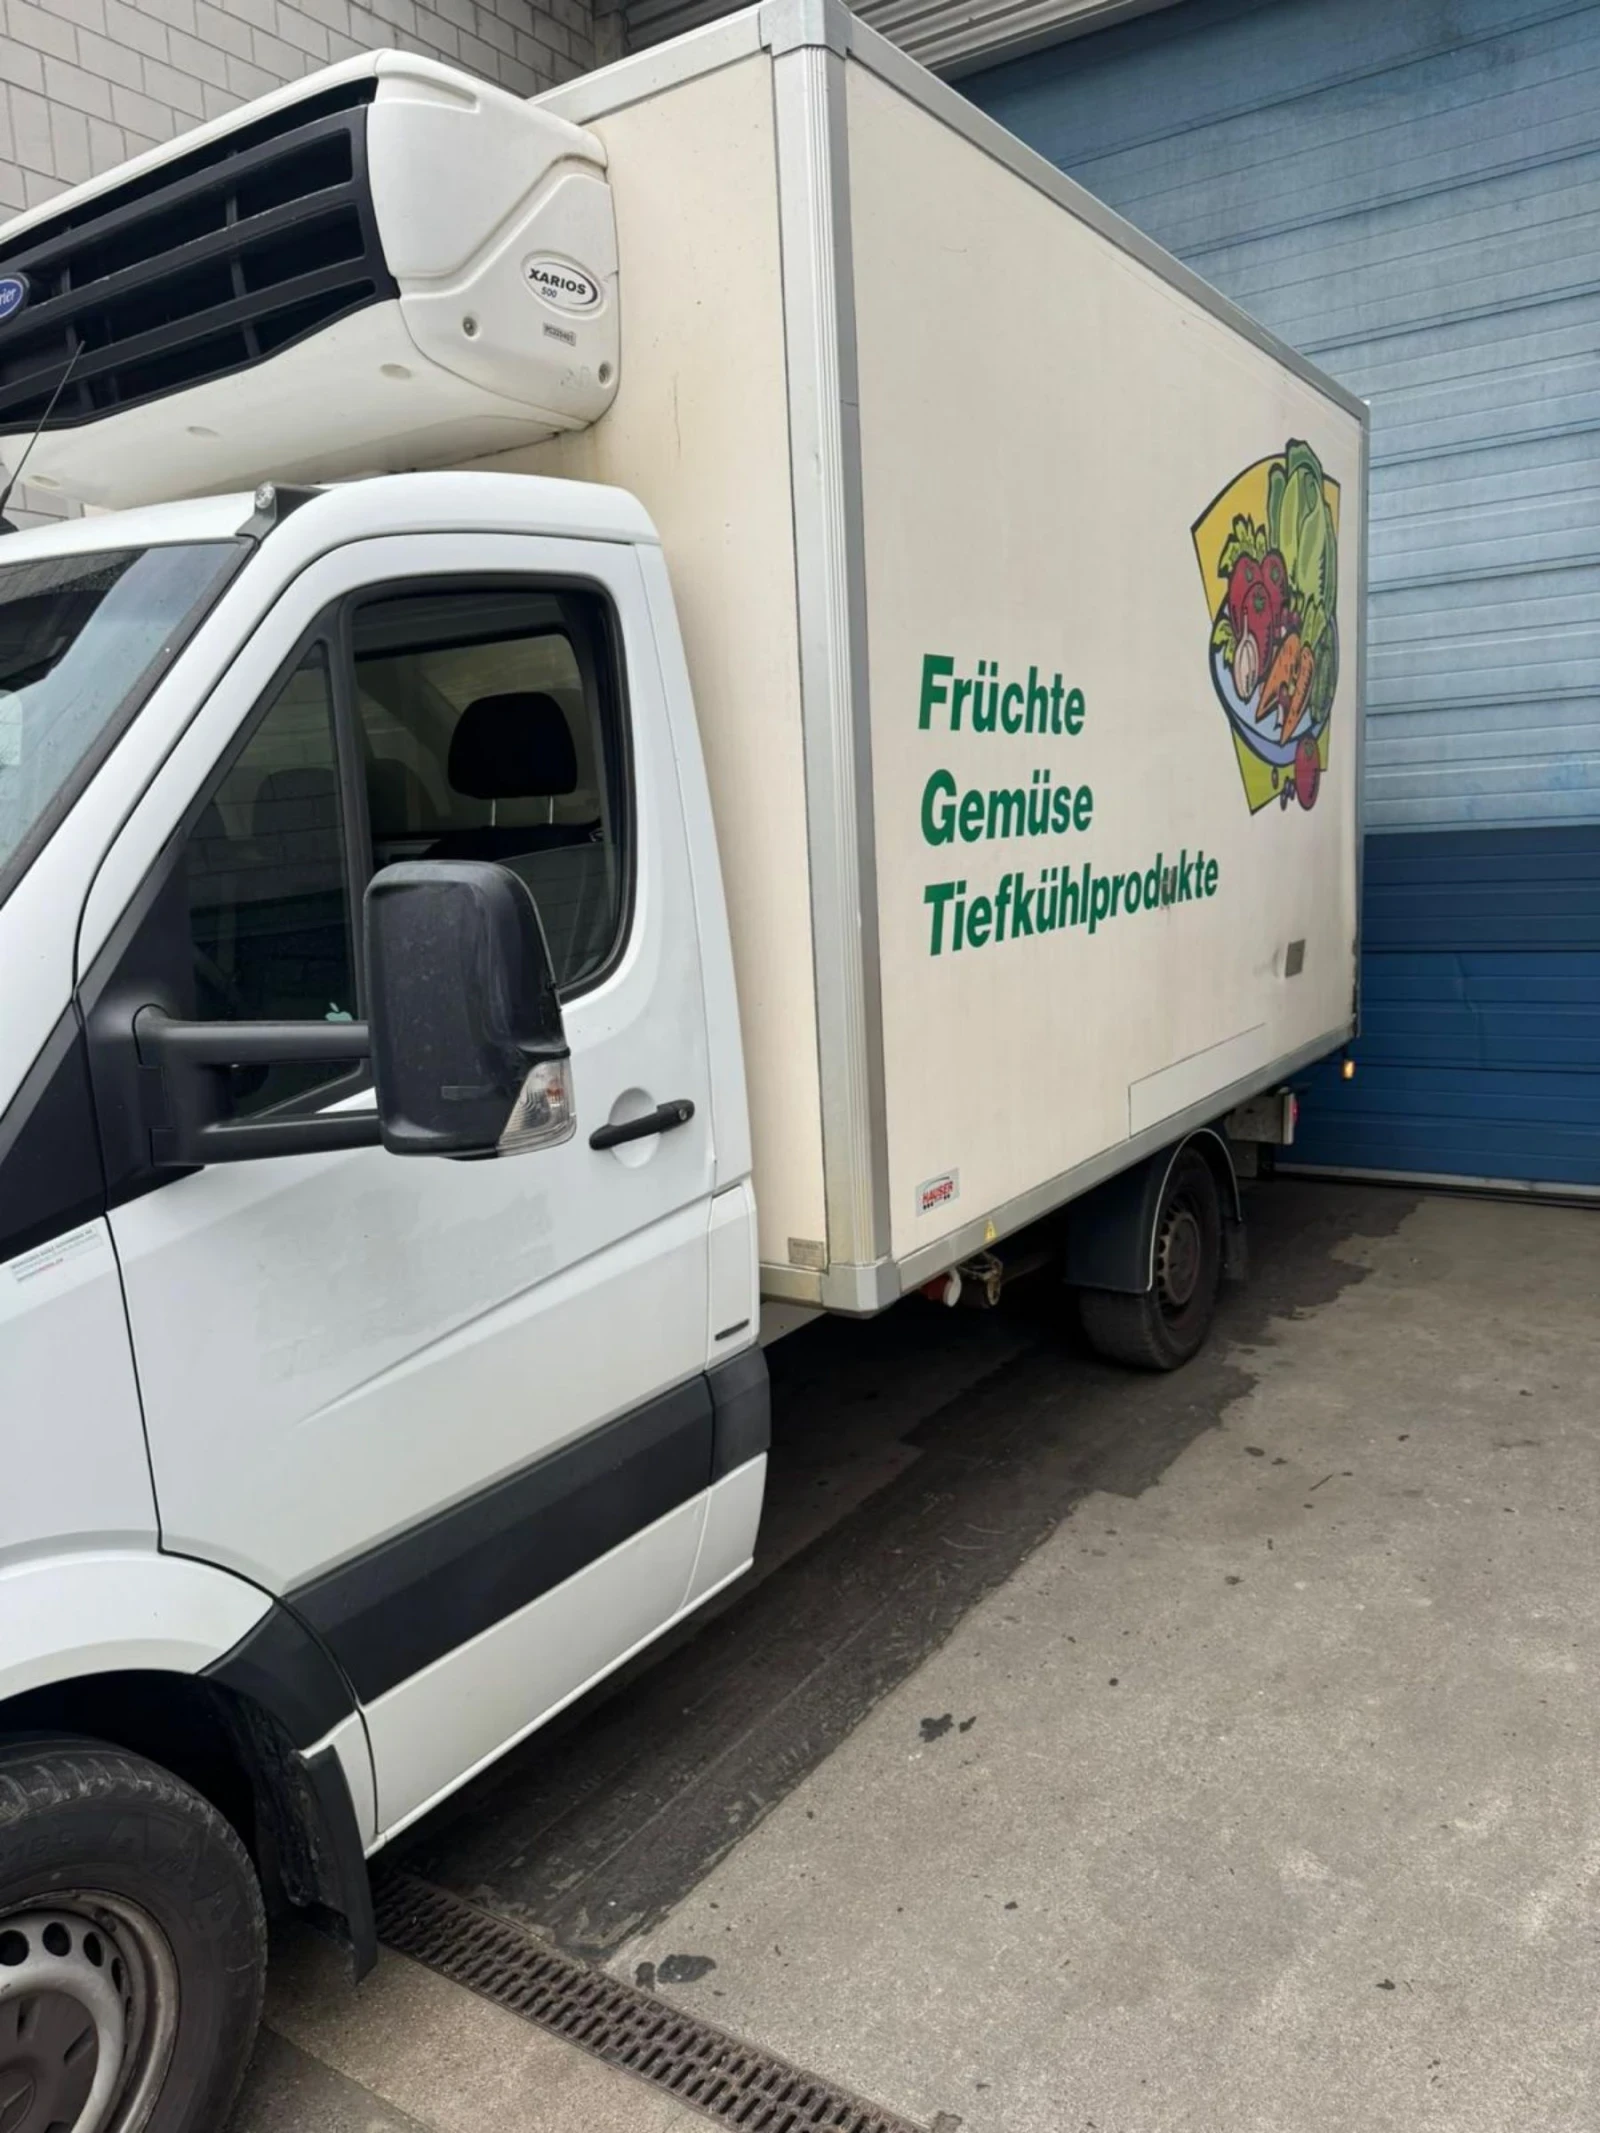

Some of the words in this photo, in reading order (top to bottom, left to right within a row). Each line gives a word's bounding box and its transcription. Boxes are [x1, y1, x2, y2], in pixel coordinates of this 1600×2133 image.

[529, 267, 587, 295] XARIOS
[541, 286, 557, 298] 500
[918, 653, 1086, 736] Früchte
[920, 768, 1094, 847] Gemüse
[923, 849, 1219, 956] Tiefkühlprodukte
